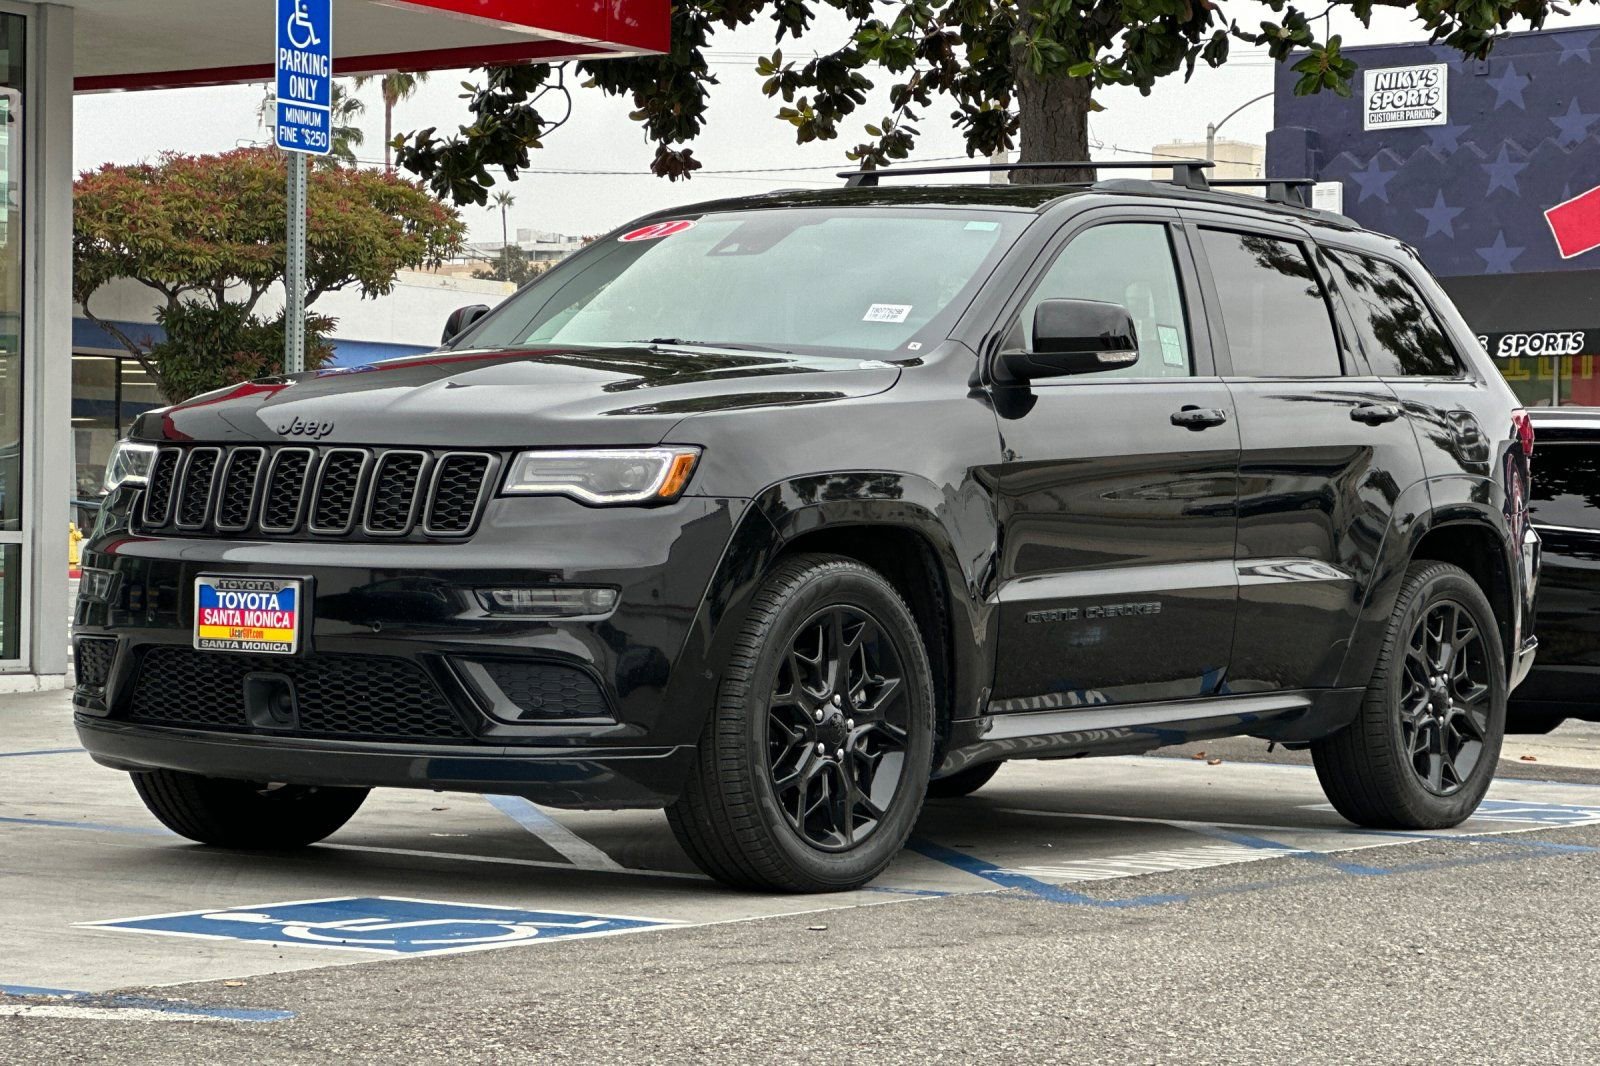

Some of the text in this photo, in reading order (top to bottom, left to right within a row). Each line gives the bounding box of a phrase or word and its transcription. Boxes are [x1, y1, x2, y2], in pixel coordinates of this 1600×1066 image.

[279, 47, 328, 77] PARKING
[289, 75, 318, 100] ONLY
[1375, 68, 1438, 91] NIKY'S
[1369, 87, 1440, 111] SPORTS
[285, 107, 321, 127] MINIMUM
[1370, 107, 1435, 123] CUSTOMER PARKING
[280, 126, 327, 147] FINE $250
[1497, 332, 1585, 357] SPORTS
[277, 416, 335, 440] Jeep
[220, 580, 273, 591] TOYOTA
[216, 592, 280, 611] TOYOTA
[1025, 601, 1163, 623] GRAND CHEROKEE
[204, 609, 290, 628] SANTA MONICA
[201, 640, 289, 652] SANTA MONICA
